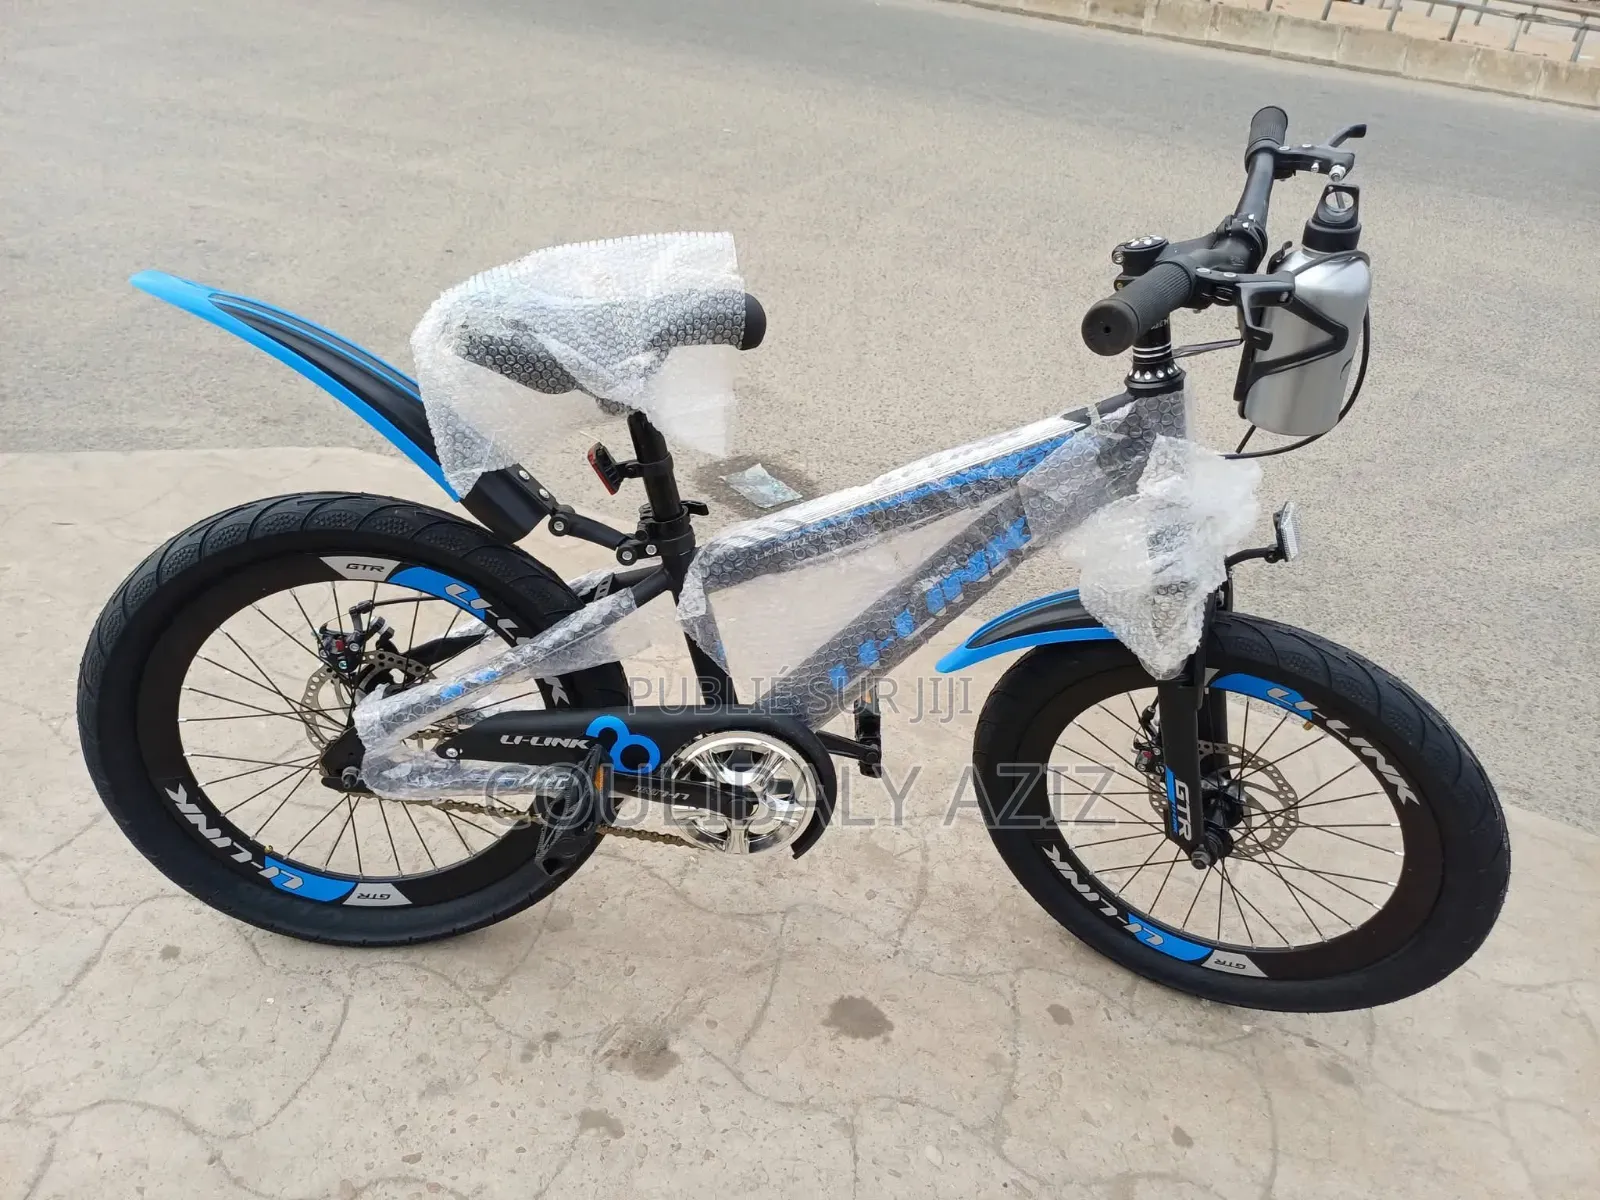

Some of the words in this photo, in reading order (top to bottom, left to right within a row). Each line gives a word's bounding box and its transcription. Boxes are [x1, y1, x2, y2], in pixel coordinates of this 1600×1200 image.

[346, 563, 385, 573] GTR
[500, 734, 590, 750] LI-LINK
[1267, 687, 1420, 806] LI-LINK
[1175, 779, 1192, 841] GTR
[164, 783, 304, 889] LI-LINK
[357, 893, 391, 901] GTR
[1041, 844, 1164, 946] LI-LINK
[1214, 958, 1247, 971] GTR
